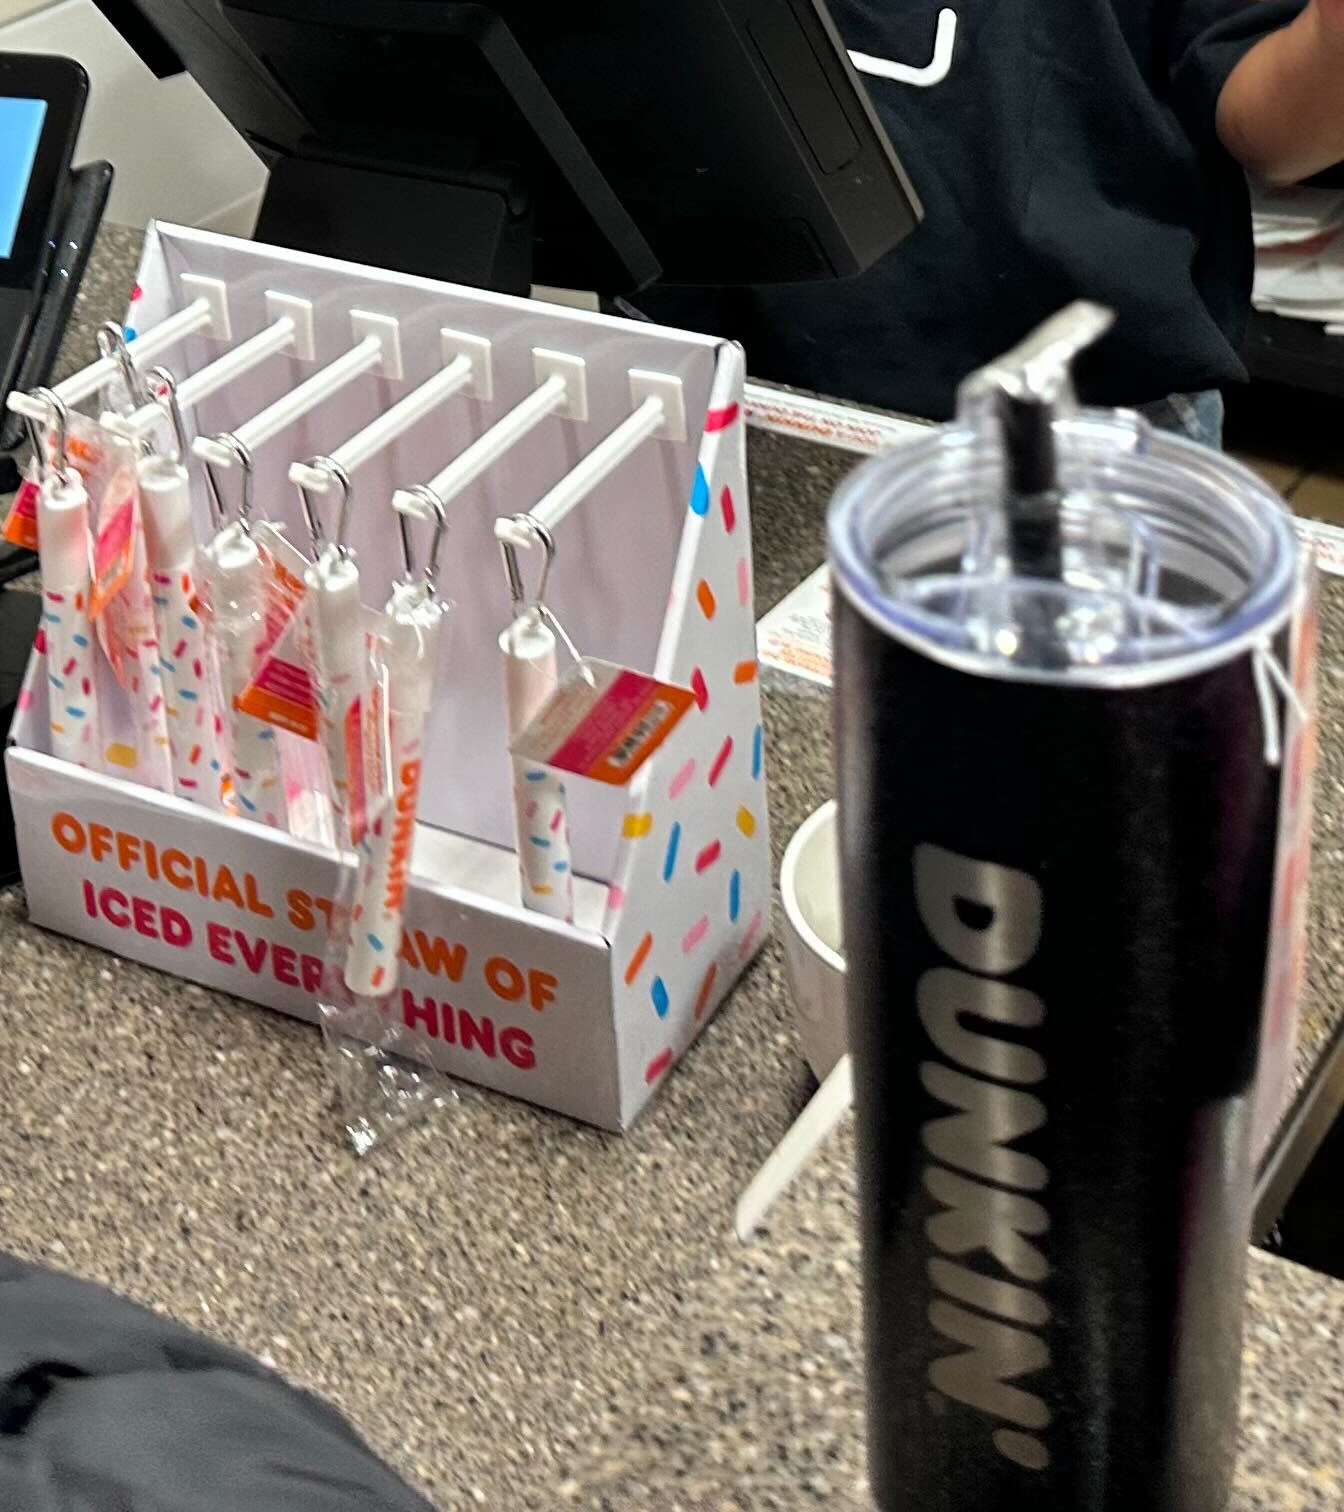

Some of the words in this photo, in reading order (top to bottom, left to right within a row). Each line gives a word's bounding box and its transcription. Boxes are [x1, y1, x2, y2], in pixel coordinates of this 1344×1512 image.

[52, 811, 273, 918] OFFICIAL
[287, 889, 468, 983] STAW
[484, 956, 558, 1012] OF
[83, 880, 193, 948] ICED
[207, 922, 536, 1070] EVERHING
[911, 841, 1051, 1471] DUNKIN'
